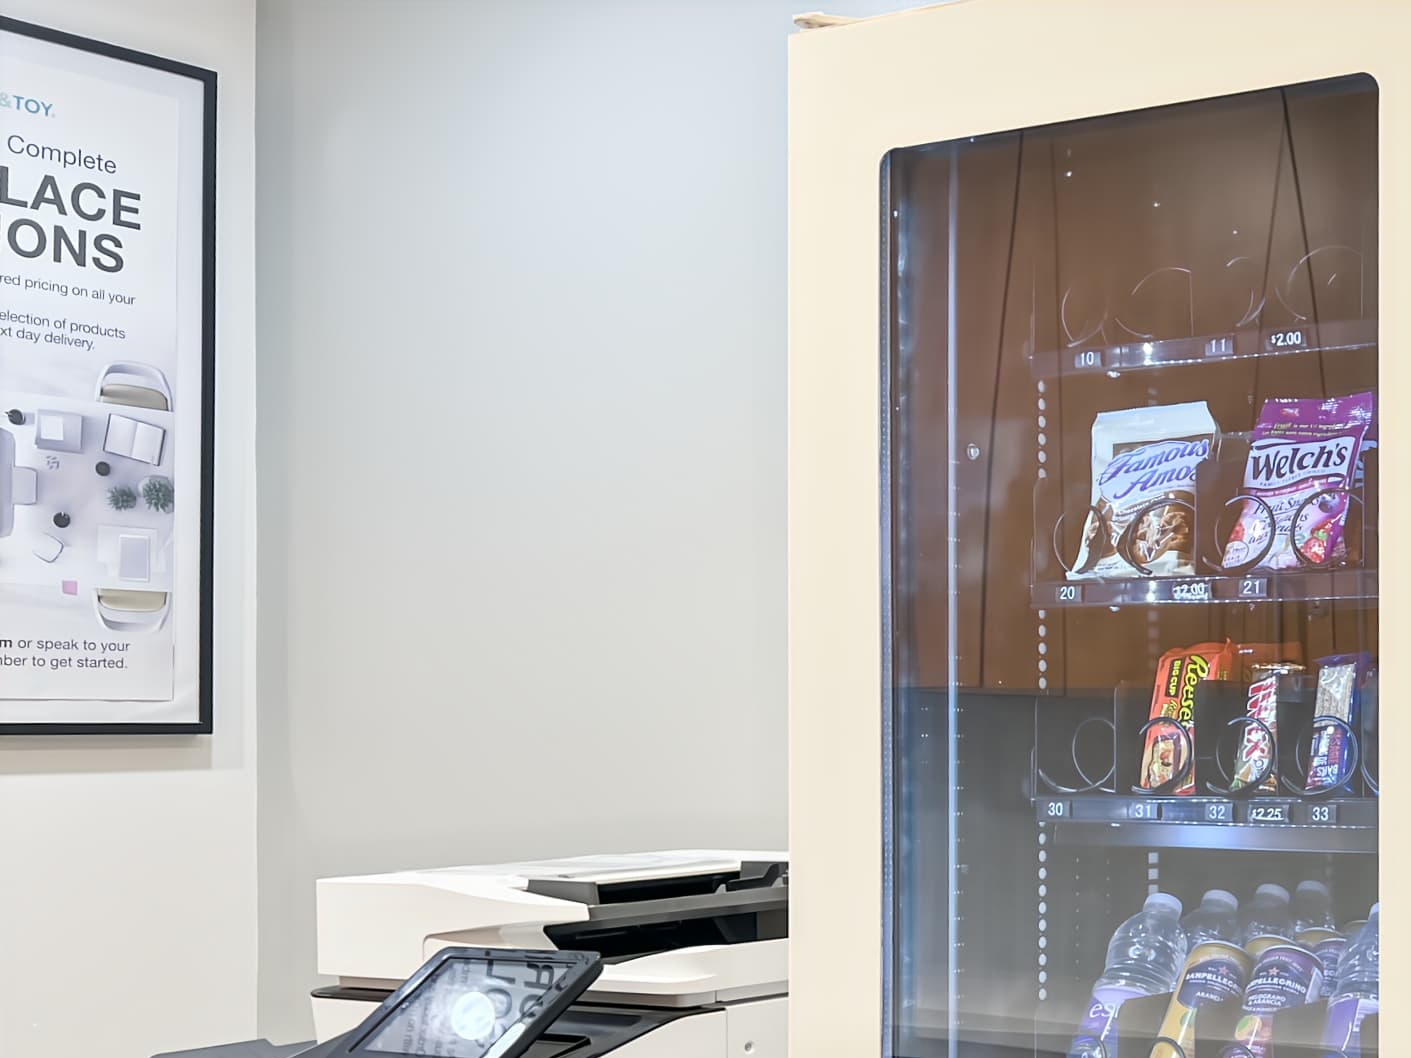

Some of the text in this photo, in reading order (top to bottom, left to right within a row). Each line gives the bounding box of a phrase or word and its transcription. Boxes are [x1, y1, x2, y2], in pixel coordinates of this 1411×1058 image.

[7, 134, 117, 174] Complete
[25, 278, 68, 296] pricing
[72, 286, 88, 297] on
[91, 288, 105, 300] all
[108, 292, 136, 305] your
[16, 328, 41, 343] day
[44, 332, 95, 351] delivery.
[53, 317, 67, 329] of
[70, 322, 126, 339] products
[1080, 331, 1302, 366] 10 11 $2.00
[1099, 439, 1209, 486] Famous
[1250, 443, 1348, 481] Welch's
[1060, 586, 1075, 600] 20
[1243, 580, 1261, 595] 21
[17, 639, 32, 648] or
[36, 638, 79, 652] speak
[83, 639, 97, 651] to
[100, 641, 131, 654] your
[32, 655, 46, 667] to
[50, 656, 73, 670] get
[76, 656, 128, 669] started.
[1047, 803, 1064, 817] 30
[1135, 804, 1151, 818] 31
[1209, 806, 1226, 820] 32
[1312, 807, 1330, 821] 33
